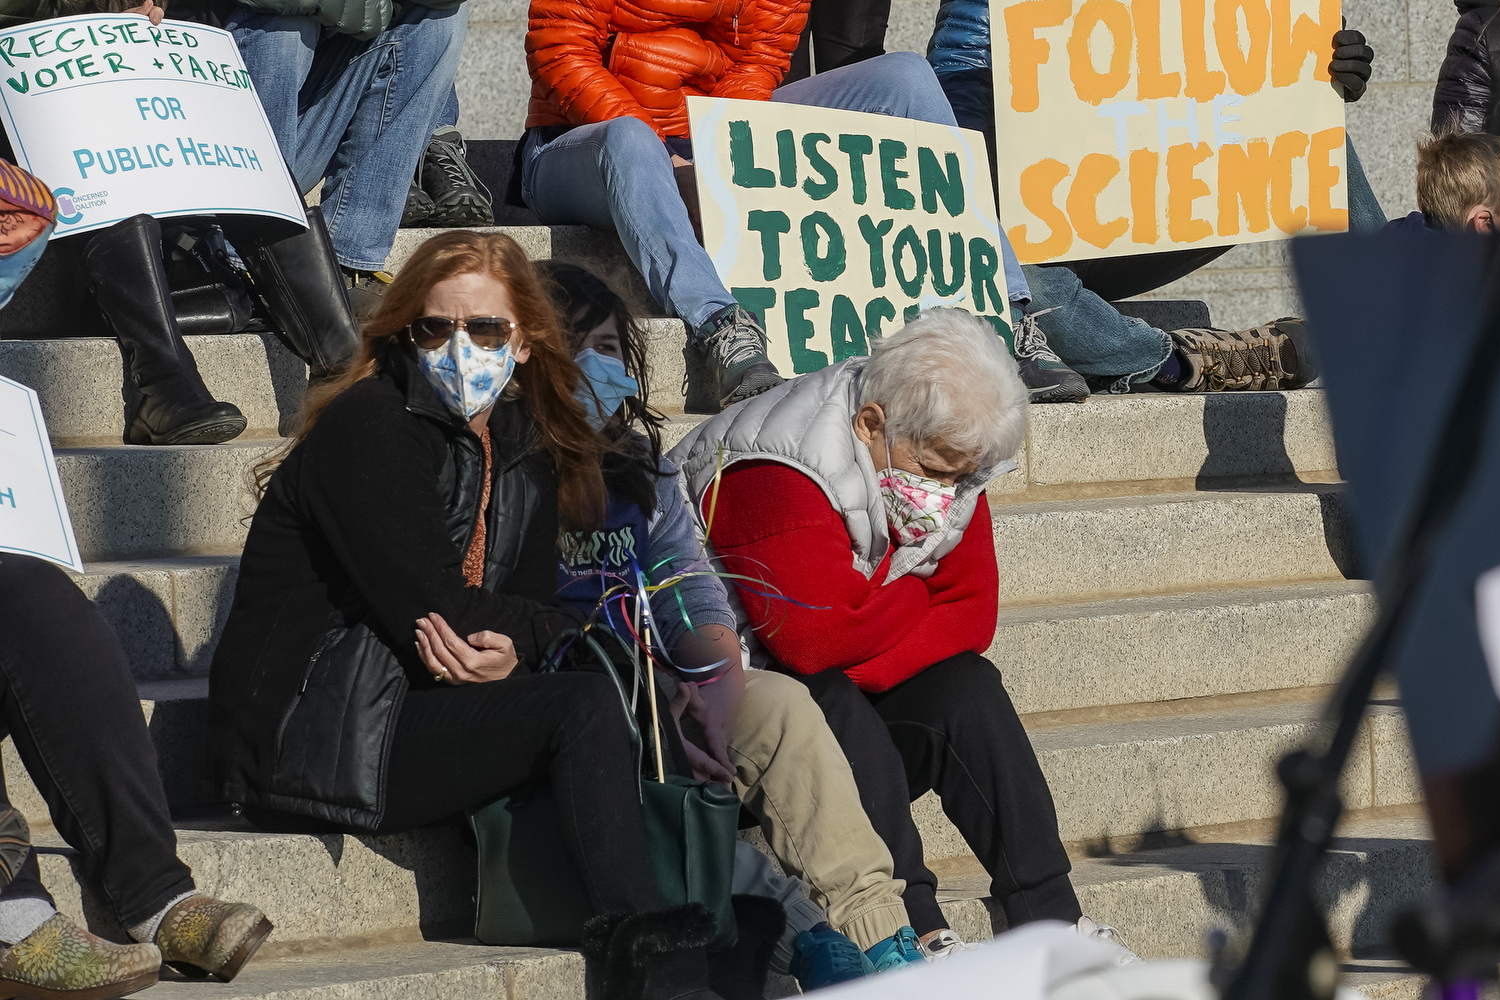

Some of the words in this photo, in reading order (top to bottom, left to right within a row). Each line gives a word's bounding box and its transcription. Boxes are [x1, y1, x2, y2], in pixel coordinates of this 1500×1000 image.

[0, 22, 199, 68] REGISTERED
[5, 52, 136, 94] VOTER
[135, 96, 187, 121] FOR
[1097, 93, 1247, 158] THE
[728, 119, 966, 218] LISTEN
[1007, 126, 1349, 265] SCIENCE
[747, 209, 847, 282] TO
[857, 213, 1005, 315] YOUR
